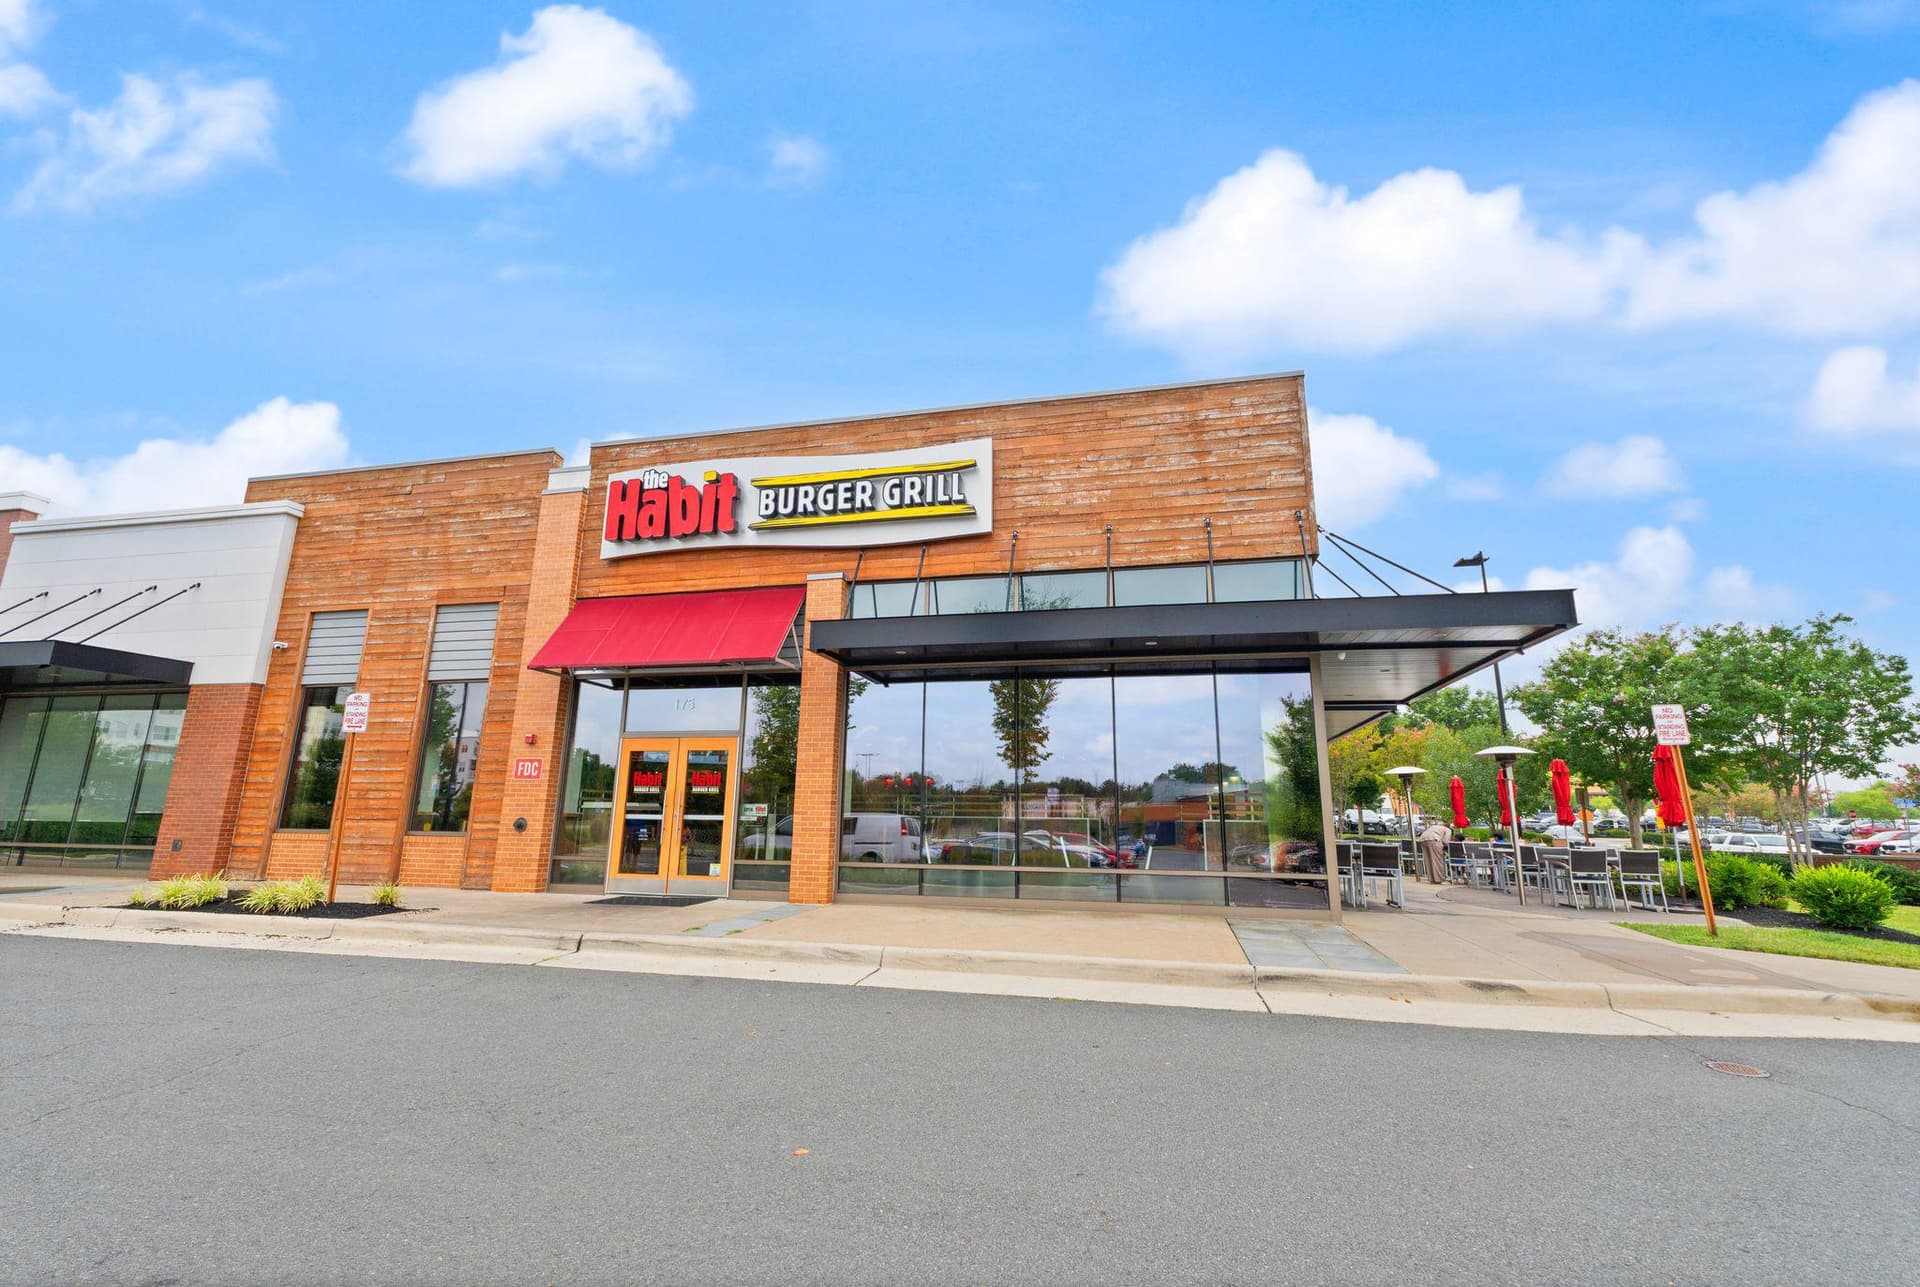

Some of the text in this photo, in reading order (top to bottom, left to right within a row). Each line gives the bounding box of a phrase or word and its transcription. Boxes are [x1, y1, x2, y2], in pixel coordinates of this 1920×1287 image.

[643, 469, 669, 489] the
[605, 470, 738, 541] Habit
[759, 472, 967, 519] BURGER GRILL
[518, 762, 539, 776] FDC
[691, 770, 722, 787] Habit
